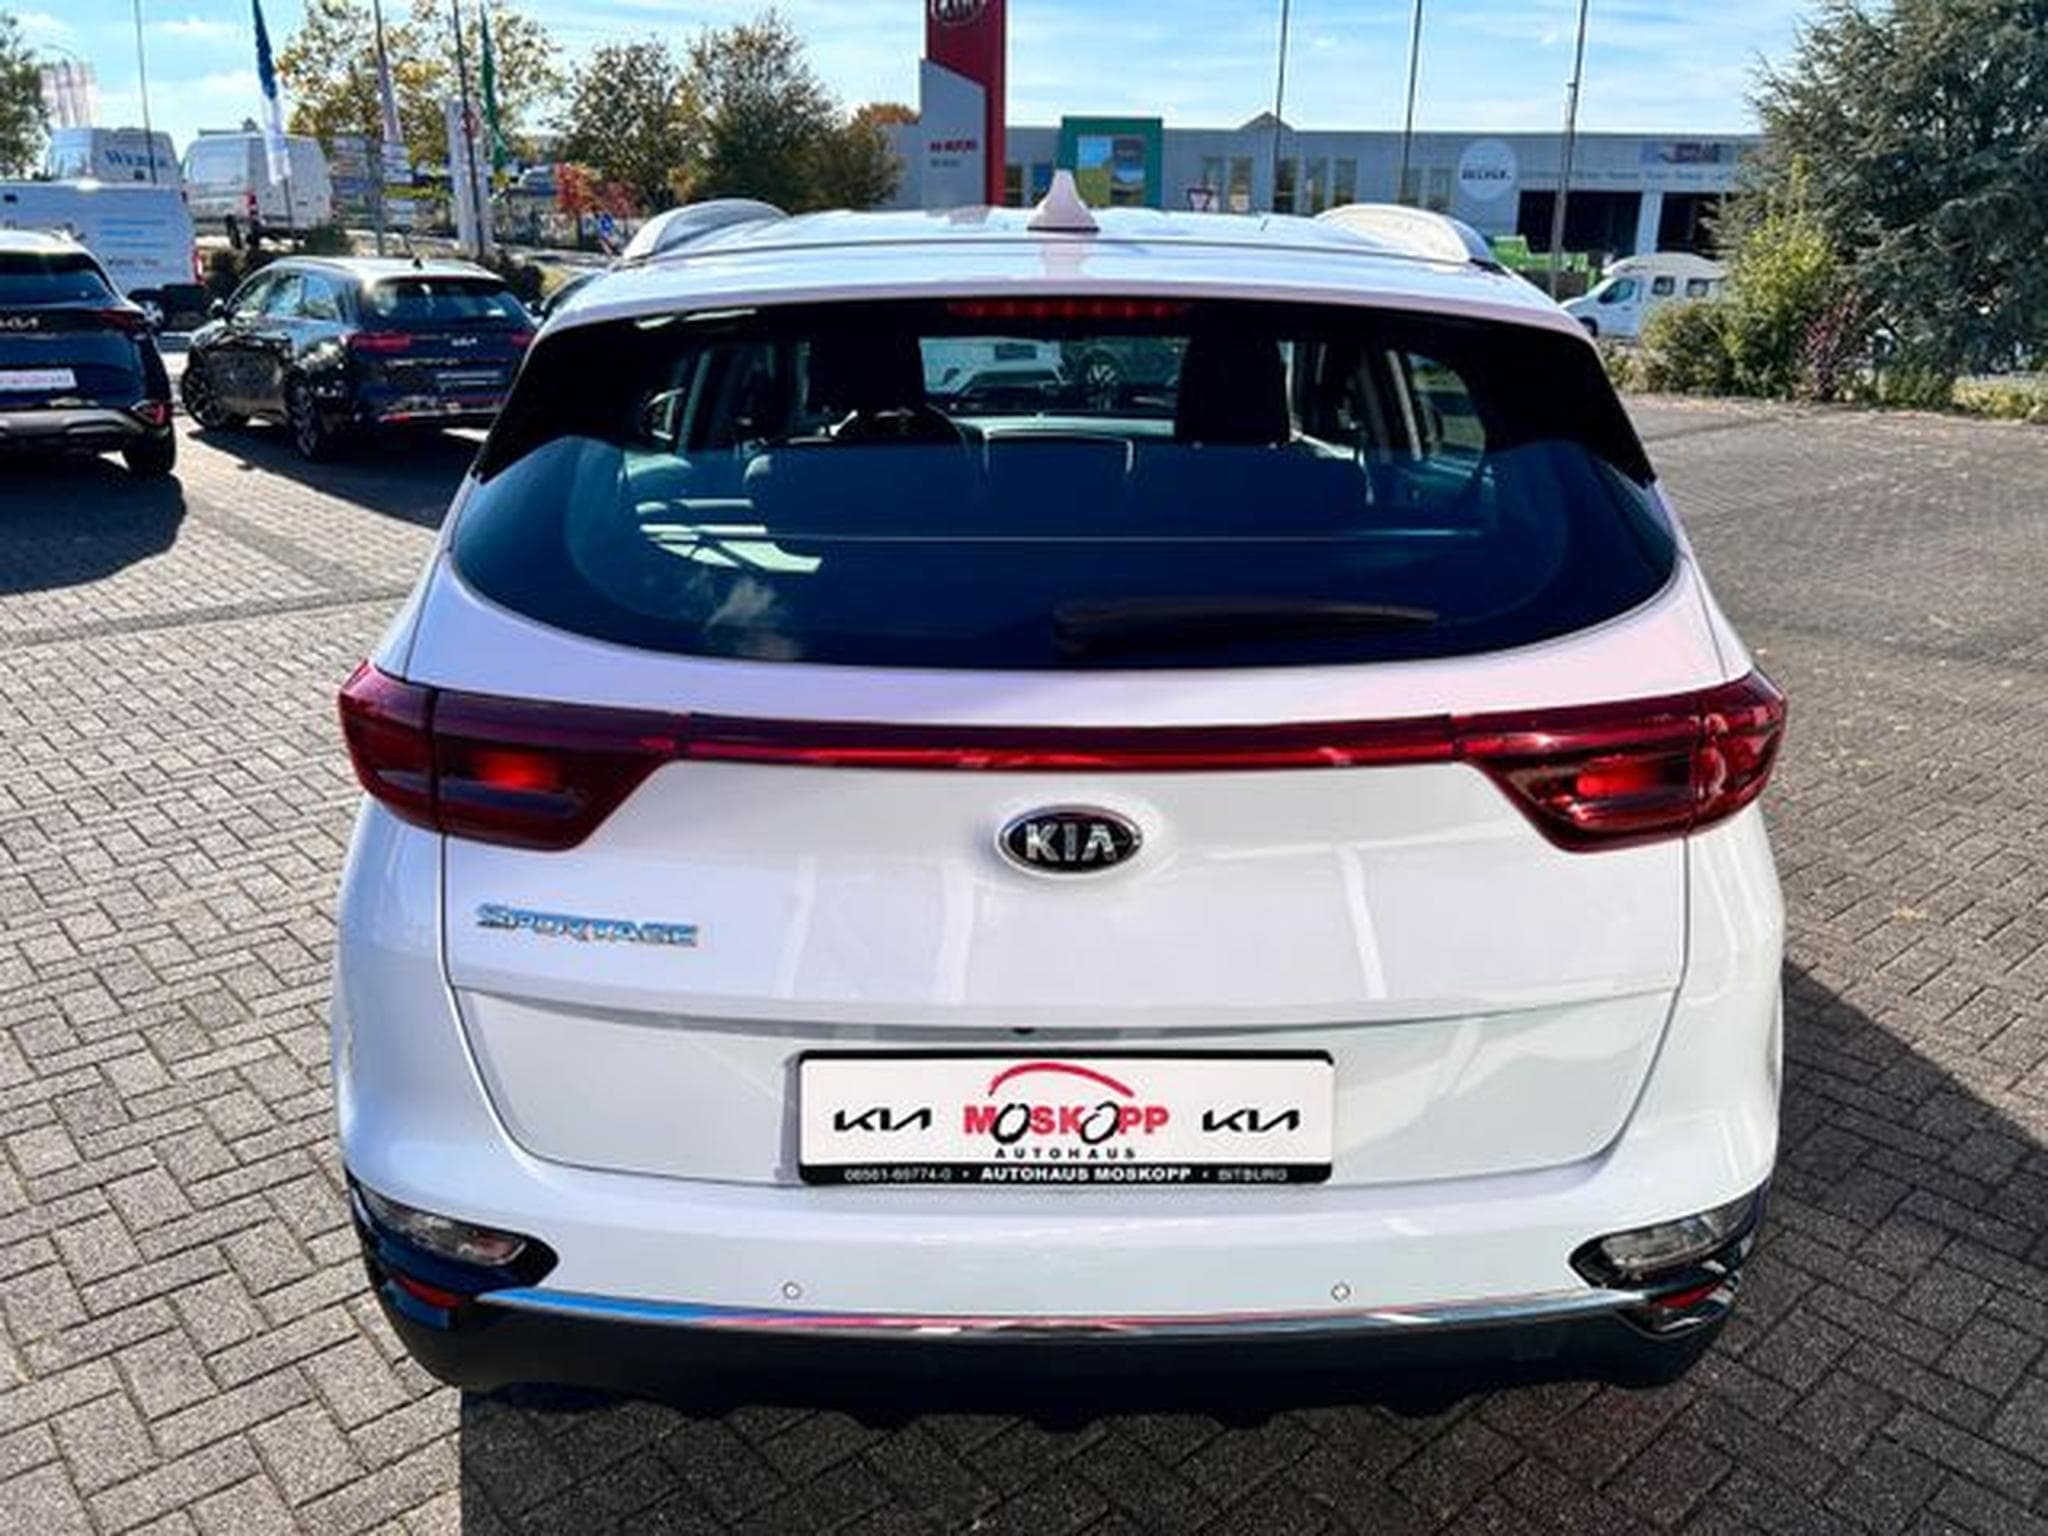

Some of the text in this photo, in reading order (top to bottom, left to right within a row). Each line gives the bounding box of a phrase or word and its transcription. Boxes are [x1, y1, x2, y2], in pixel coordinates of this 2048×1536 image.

[1025, 822, 1118, 861] KIA
[476, 902, 699, 947] SPORTAGE
[834, 1107, 932, 1131] KIA
[963, 1101, 1170, 1145] MOSKOPP
[1202, 1108, 1300, 1132] KIA
[994, 1148, 1136, 1159] AUTOHAUS
[980, 1167, 1089, 1181] AUTOHAUS
[1094, 1167, 1192, 1181] MOSKOPP
[1217, 1168, 1288, 1181] BITBURG
